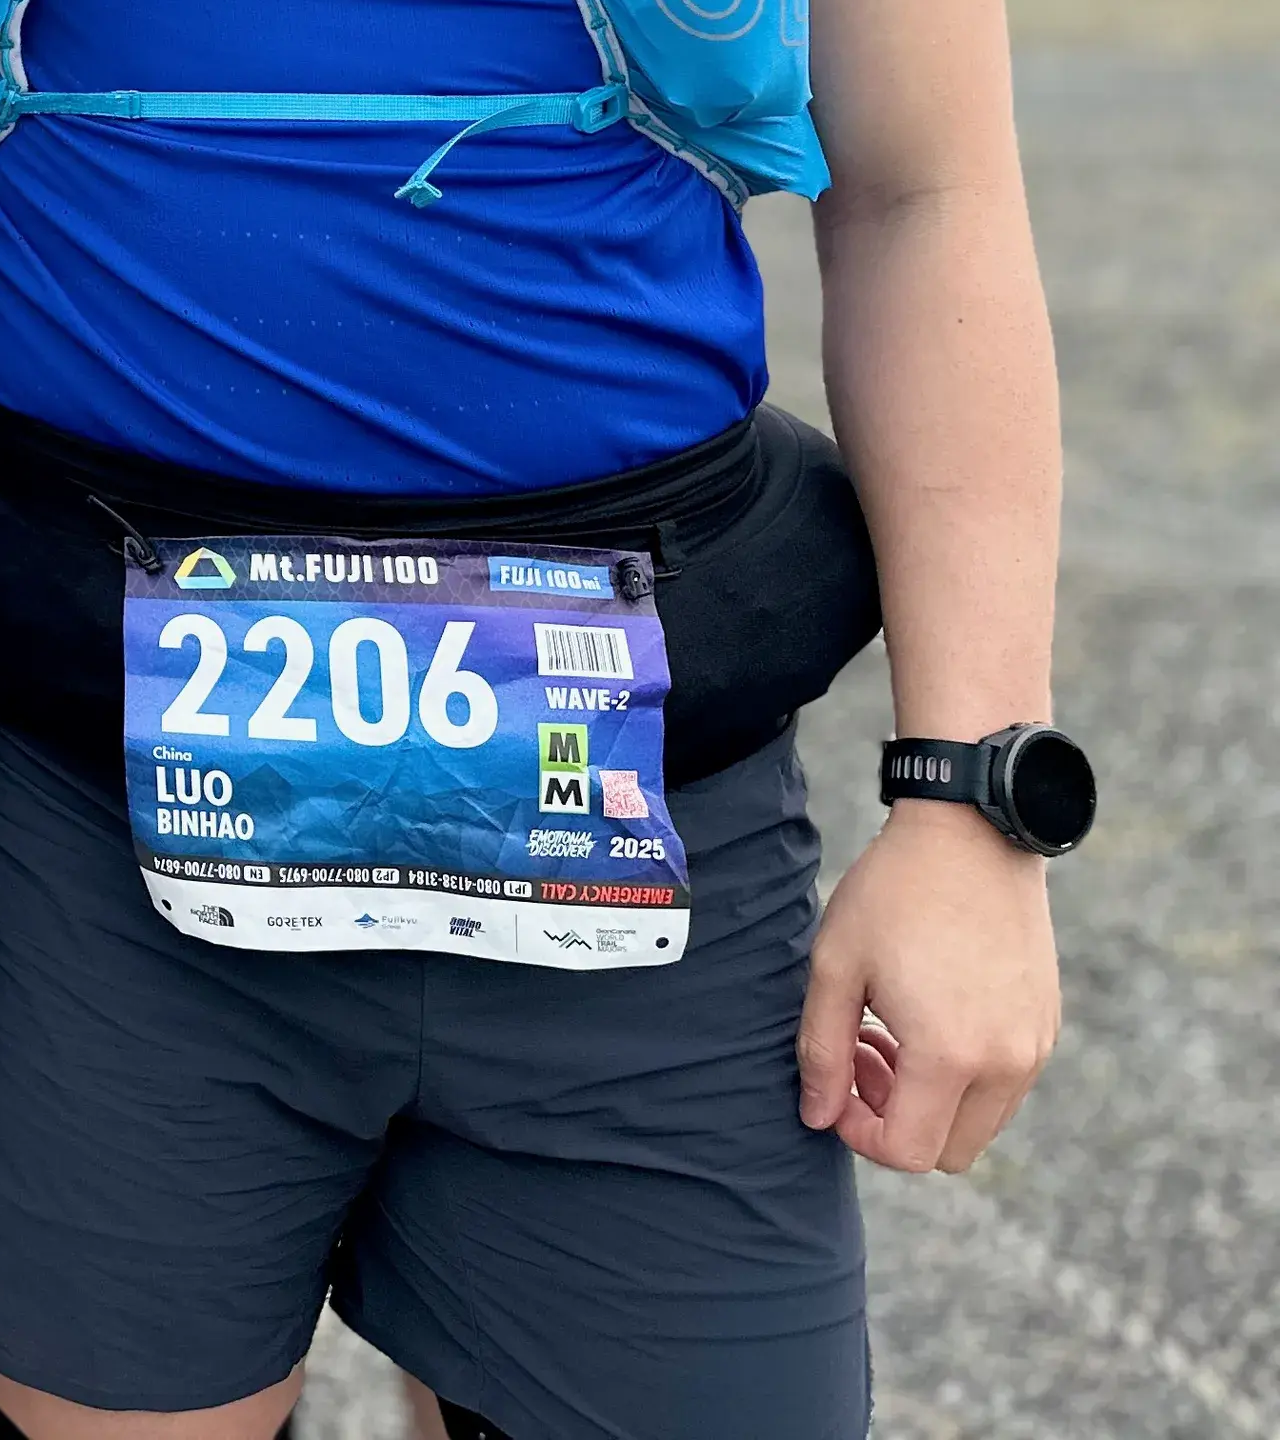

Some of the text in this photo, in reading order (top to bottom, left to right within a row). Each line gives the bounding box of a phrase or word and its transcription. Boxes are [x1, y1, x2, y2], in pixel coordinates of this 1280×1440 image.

[382, 555, 439, 585] 100
[500, 565, 542, 587] FUJI
[157, 613, 499, 749] 2206
[544, 686, 631, 711] WAVE-2
[152, 745, 193, 761] China
[548, 732, 581, 763] M
[155, 765, 233, 807] LUO
[544, 777, 584, 807] M
[156, 808, 255, 841] BINHAO
[609, 836, 665, 860] 2025
[153, 856, 675, 905] EMERGENCY CALL JP1 080-4138-3184 JP2 080-7700-6975 EN 080-7700-6874
[449, 925, 475, 938] VITAL
